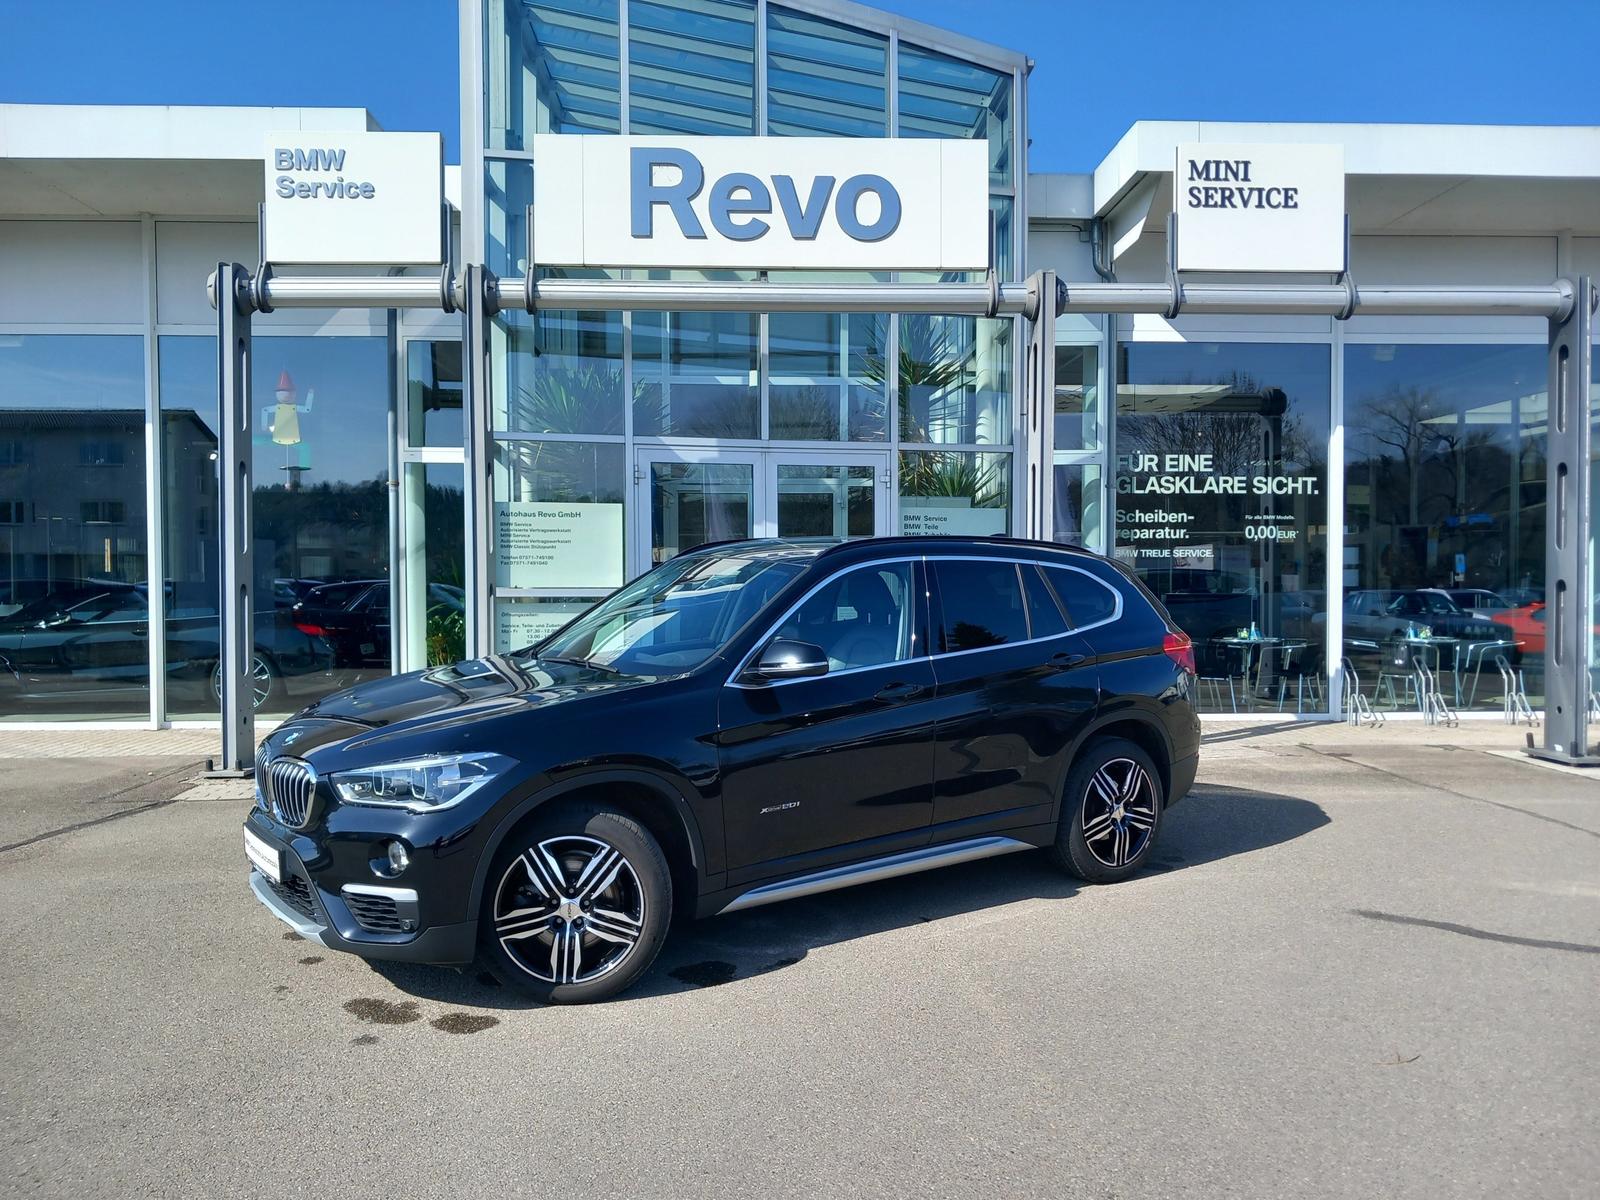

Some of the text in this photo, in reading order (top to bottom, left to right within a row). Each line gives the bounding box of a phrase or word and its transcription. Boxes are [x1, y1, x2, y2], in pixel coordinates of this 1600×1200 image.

[275, 148, 346, 171] BMW
[1188, 159, 1252, 182] MINI
[276, 175, 375, 199] Service
[630, 147, 902, 243] Revo
[1188, 186, 1298, 209] SERVICE
[1117, 450, 1213, 472] FÜR EINE
[1116, 475, 1319, 495] GLASKLARE SICHT.
[500, 510, 536, 518] Autohaus
[1116, 509, 1195, 523] Scheiben-
[1115, 527, 1189, 541] reparatur.
[1245, 525, 1276, 541] 0,00
[1115, 549, 1215, 558] BMW TREUE SERVICE.
